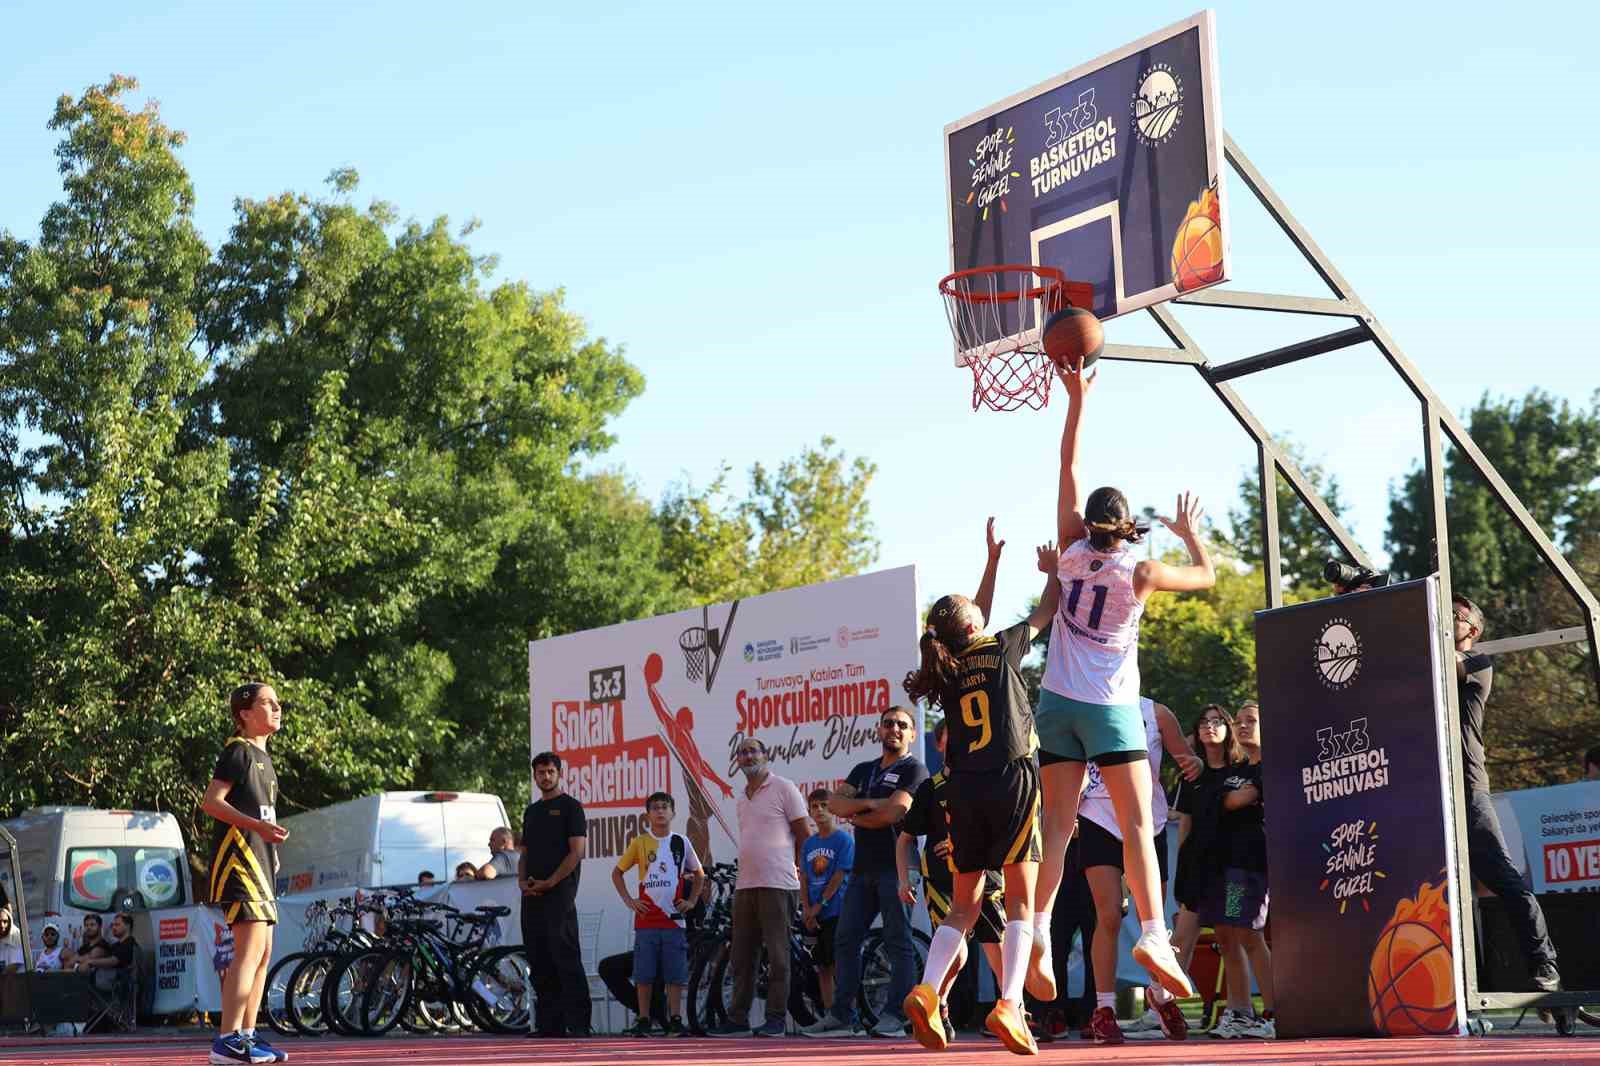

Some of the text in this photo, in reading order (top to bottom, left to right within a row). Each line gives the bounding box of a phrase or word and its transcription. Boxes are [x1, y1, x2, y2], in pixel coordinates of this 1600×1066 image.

[1044, 87, 1098, 149] 3x3
[975, 127, 1004, 161] SPOR
[1029, 116, 1117, 179] BASKETBOL
[1031, 137, 1117, 199] TURNUVASI
[1067, 578, 1109, 631] 11
[592, 670, 622, 699] 3x3
[757, 663, 865, 691] Turnuvaya Katılan Tüm
[555, 701, 615, 753] Sokak
[735, 678, 891, 737] Sporcularımıza
[960, 690, 992, 753] 9
[822, 713, 882, 760] Dileri
[1316, 717, 1370, 762] 3x3
[1302, 747, 1390, 786] BASKETBOL
[1303, 767, 1390, 805] TURNUVASI
[1330, 819, 1366, 849] SPOR
[1332, 871, 1375, 900] GÜZEL
[1546, 847, 1571, 880] 10
